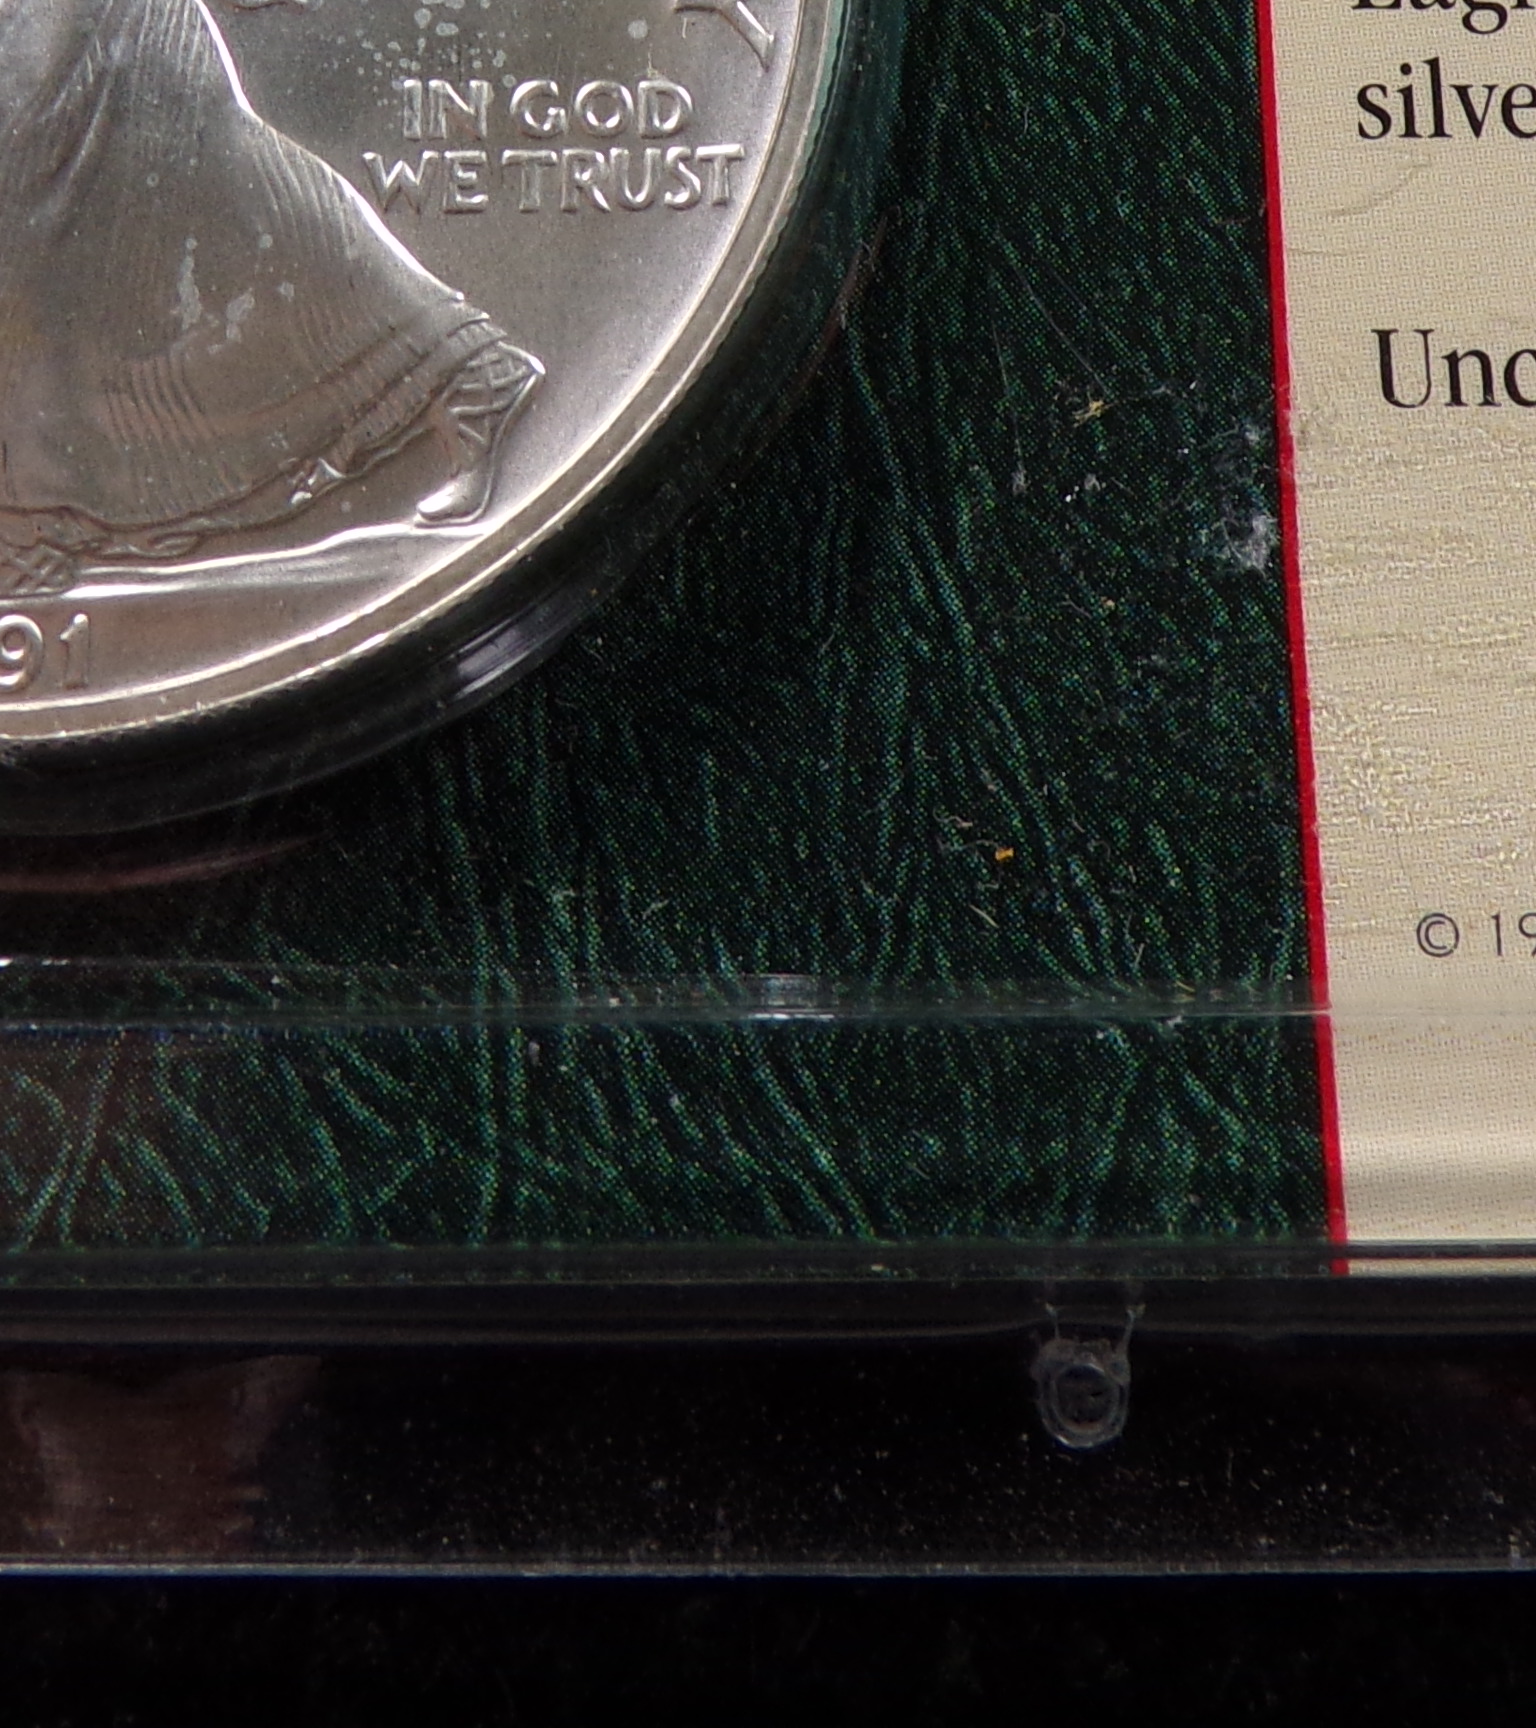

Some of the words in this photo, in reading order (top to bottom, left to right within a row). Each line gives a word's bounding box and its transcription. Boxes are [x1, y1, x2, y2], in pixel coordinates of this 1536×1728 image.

[402, 78, 492, 141] IN
[509, 78, 695, 139] GOD
[362, 149, 490, 214] WE
[501, 143, 746, 214] TRUST
